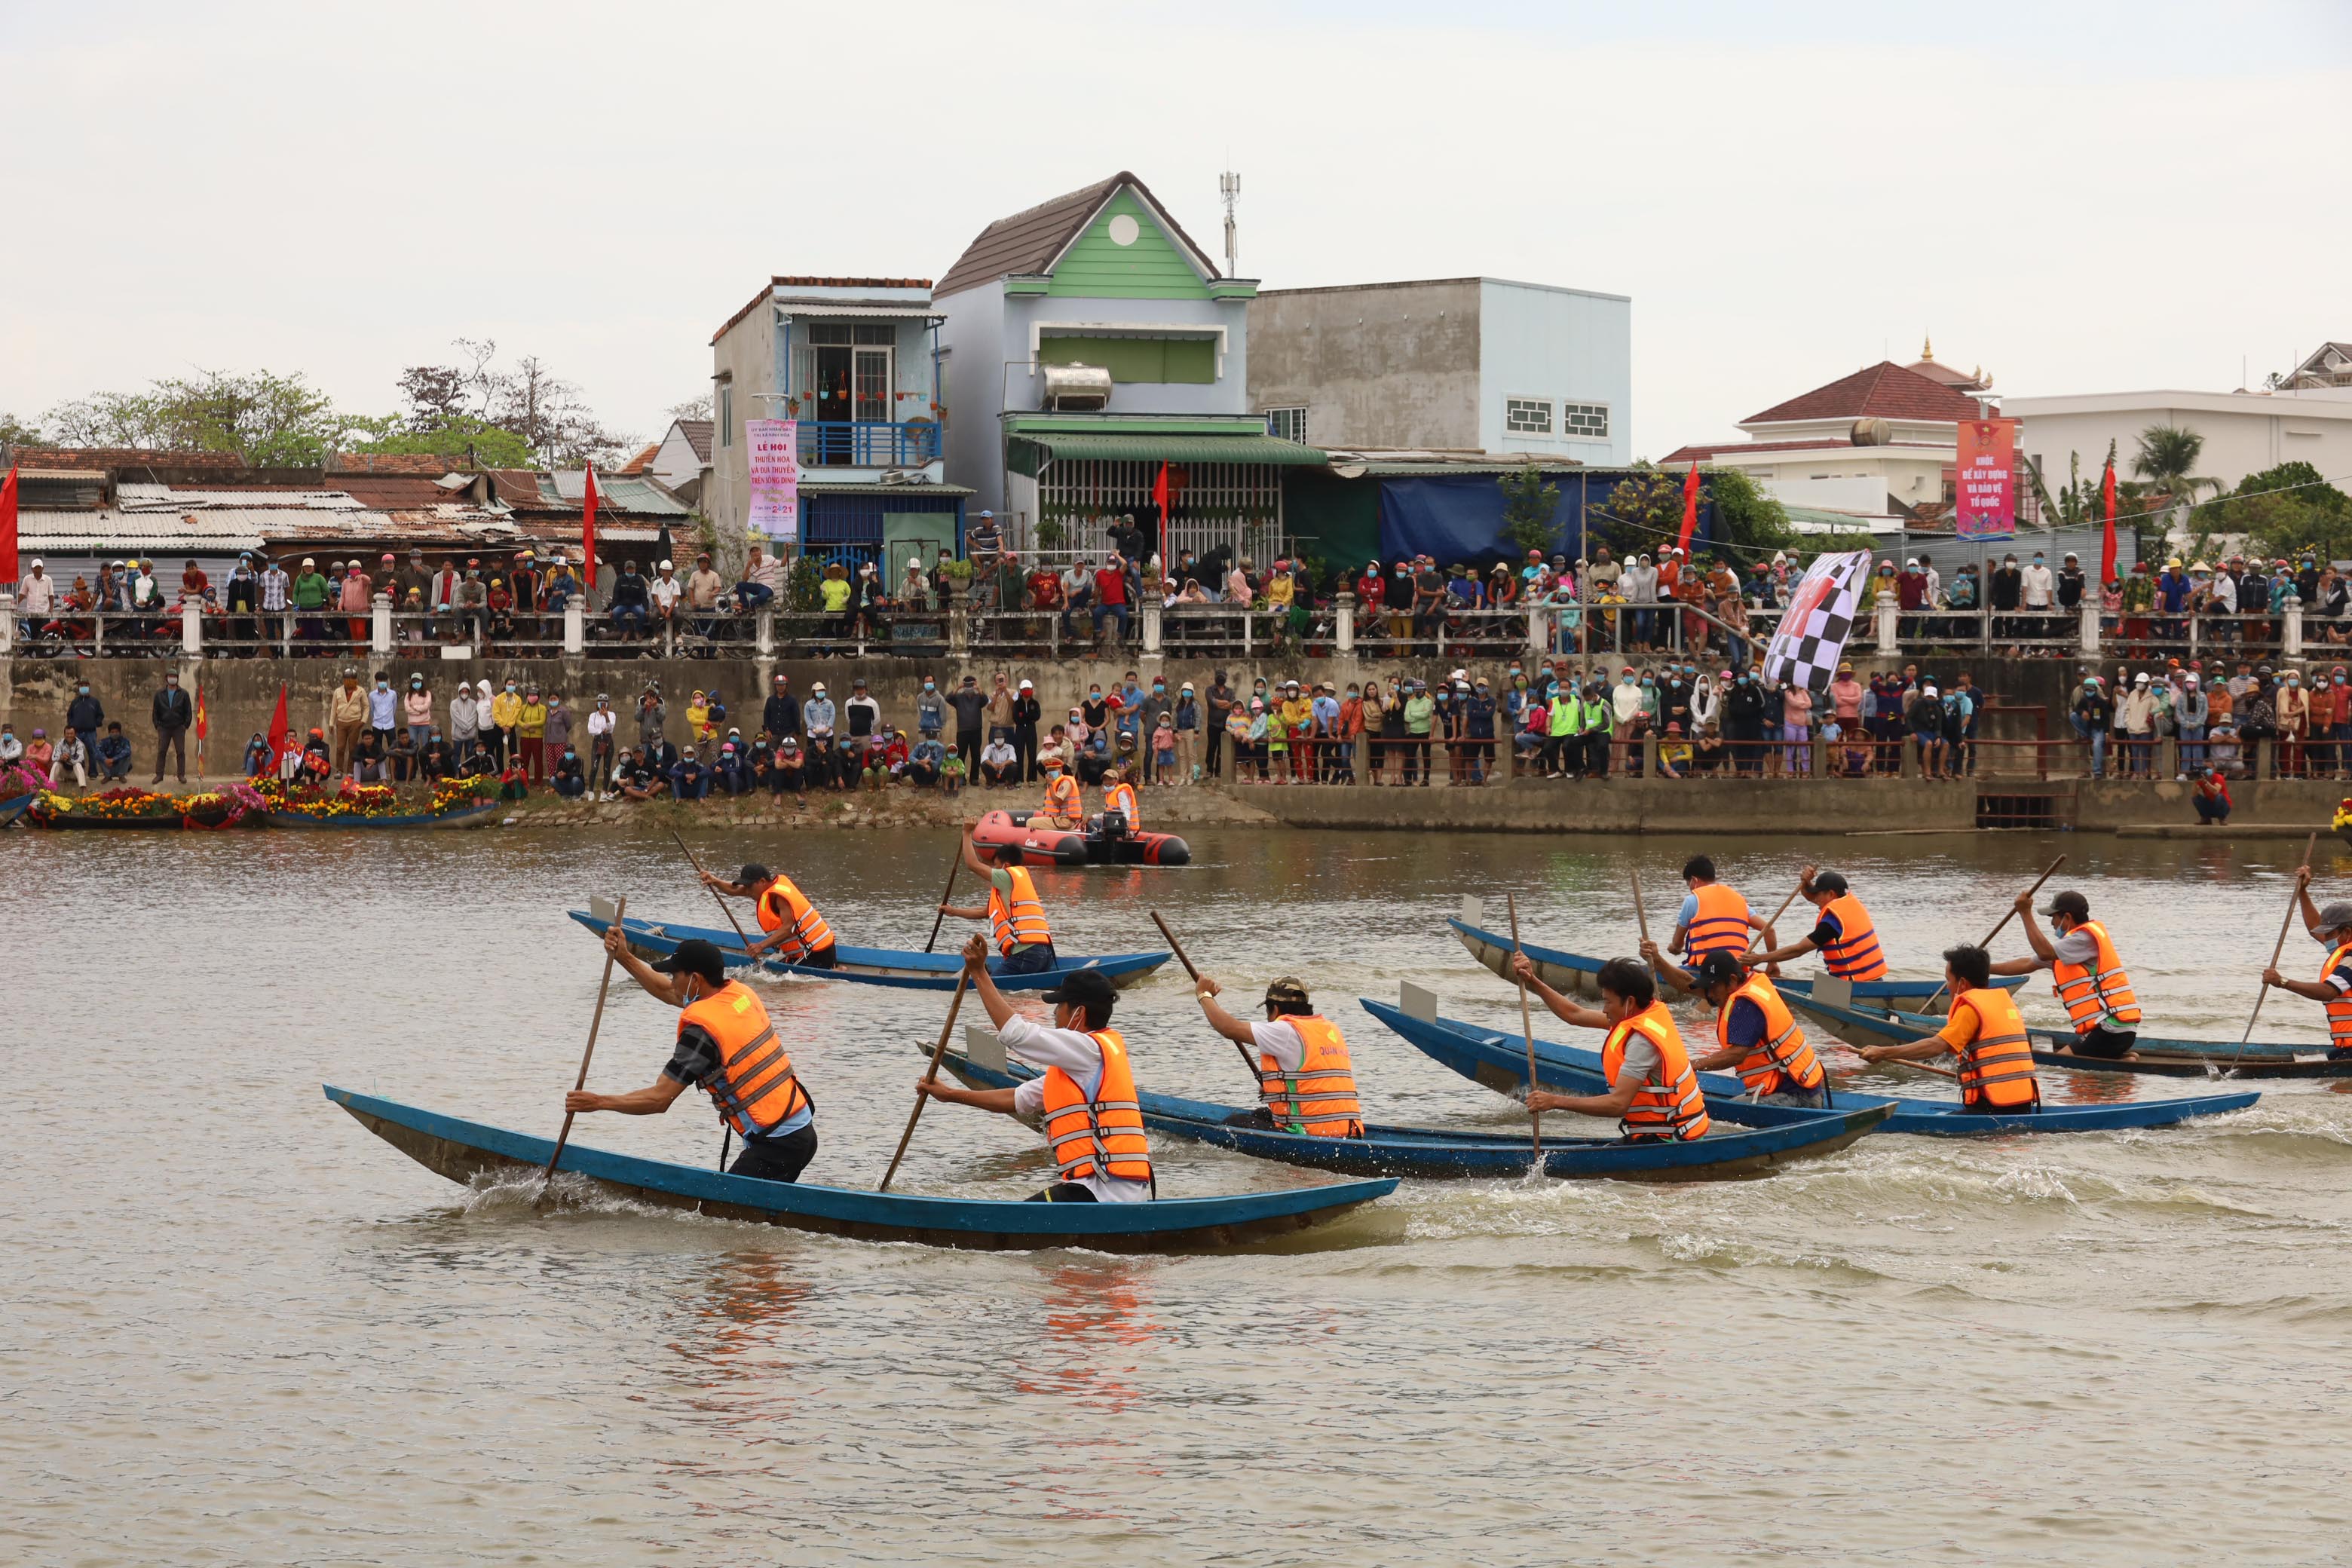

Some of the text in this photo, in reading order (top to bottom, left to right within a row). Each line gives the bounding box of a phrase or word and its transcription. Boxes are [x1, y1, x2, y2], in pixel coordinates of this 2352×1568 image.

[758, 440, 787, 454] LỄ HỘI
[755, 453, 776, 463] THUYỀN
[751, 465, 759, 473] VÀ
[772, 464, 795, 473] THUYỀN
[752, 475, 765, 484] TRÊN
[765, 475, 779, 484] SÔNG
[1971, 495, 2000, 508] TỔ QUỐC
